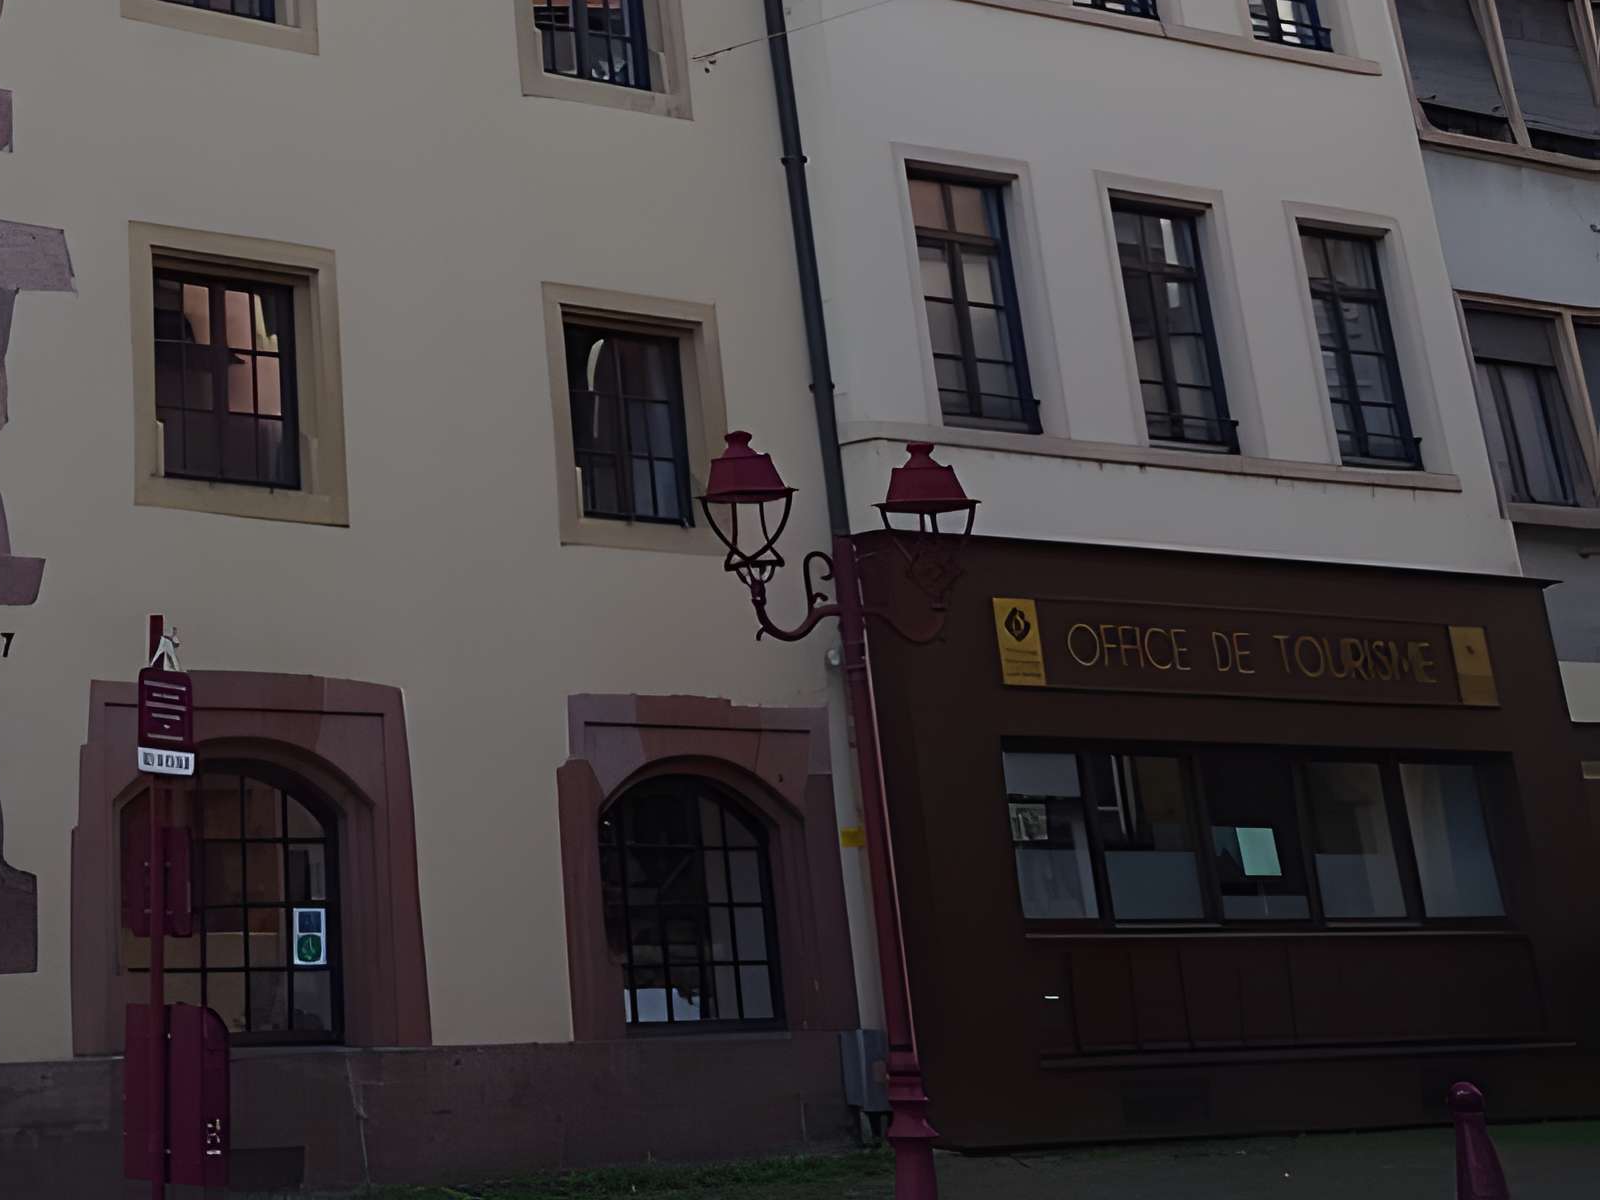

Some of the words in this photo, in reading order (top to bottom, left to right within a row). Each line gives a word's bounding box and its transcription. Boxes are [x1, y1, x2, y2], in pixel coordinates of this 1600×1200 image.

[0, 632, 15, 658] 7
[1066, 623, 1192, 672] OFFICE
[1211, 630, 1256, 675] DE
[1272, 634, 1439, 685] TOURISME
